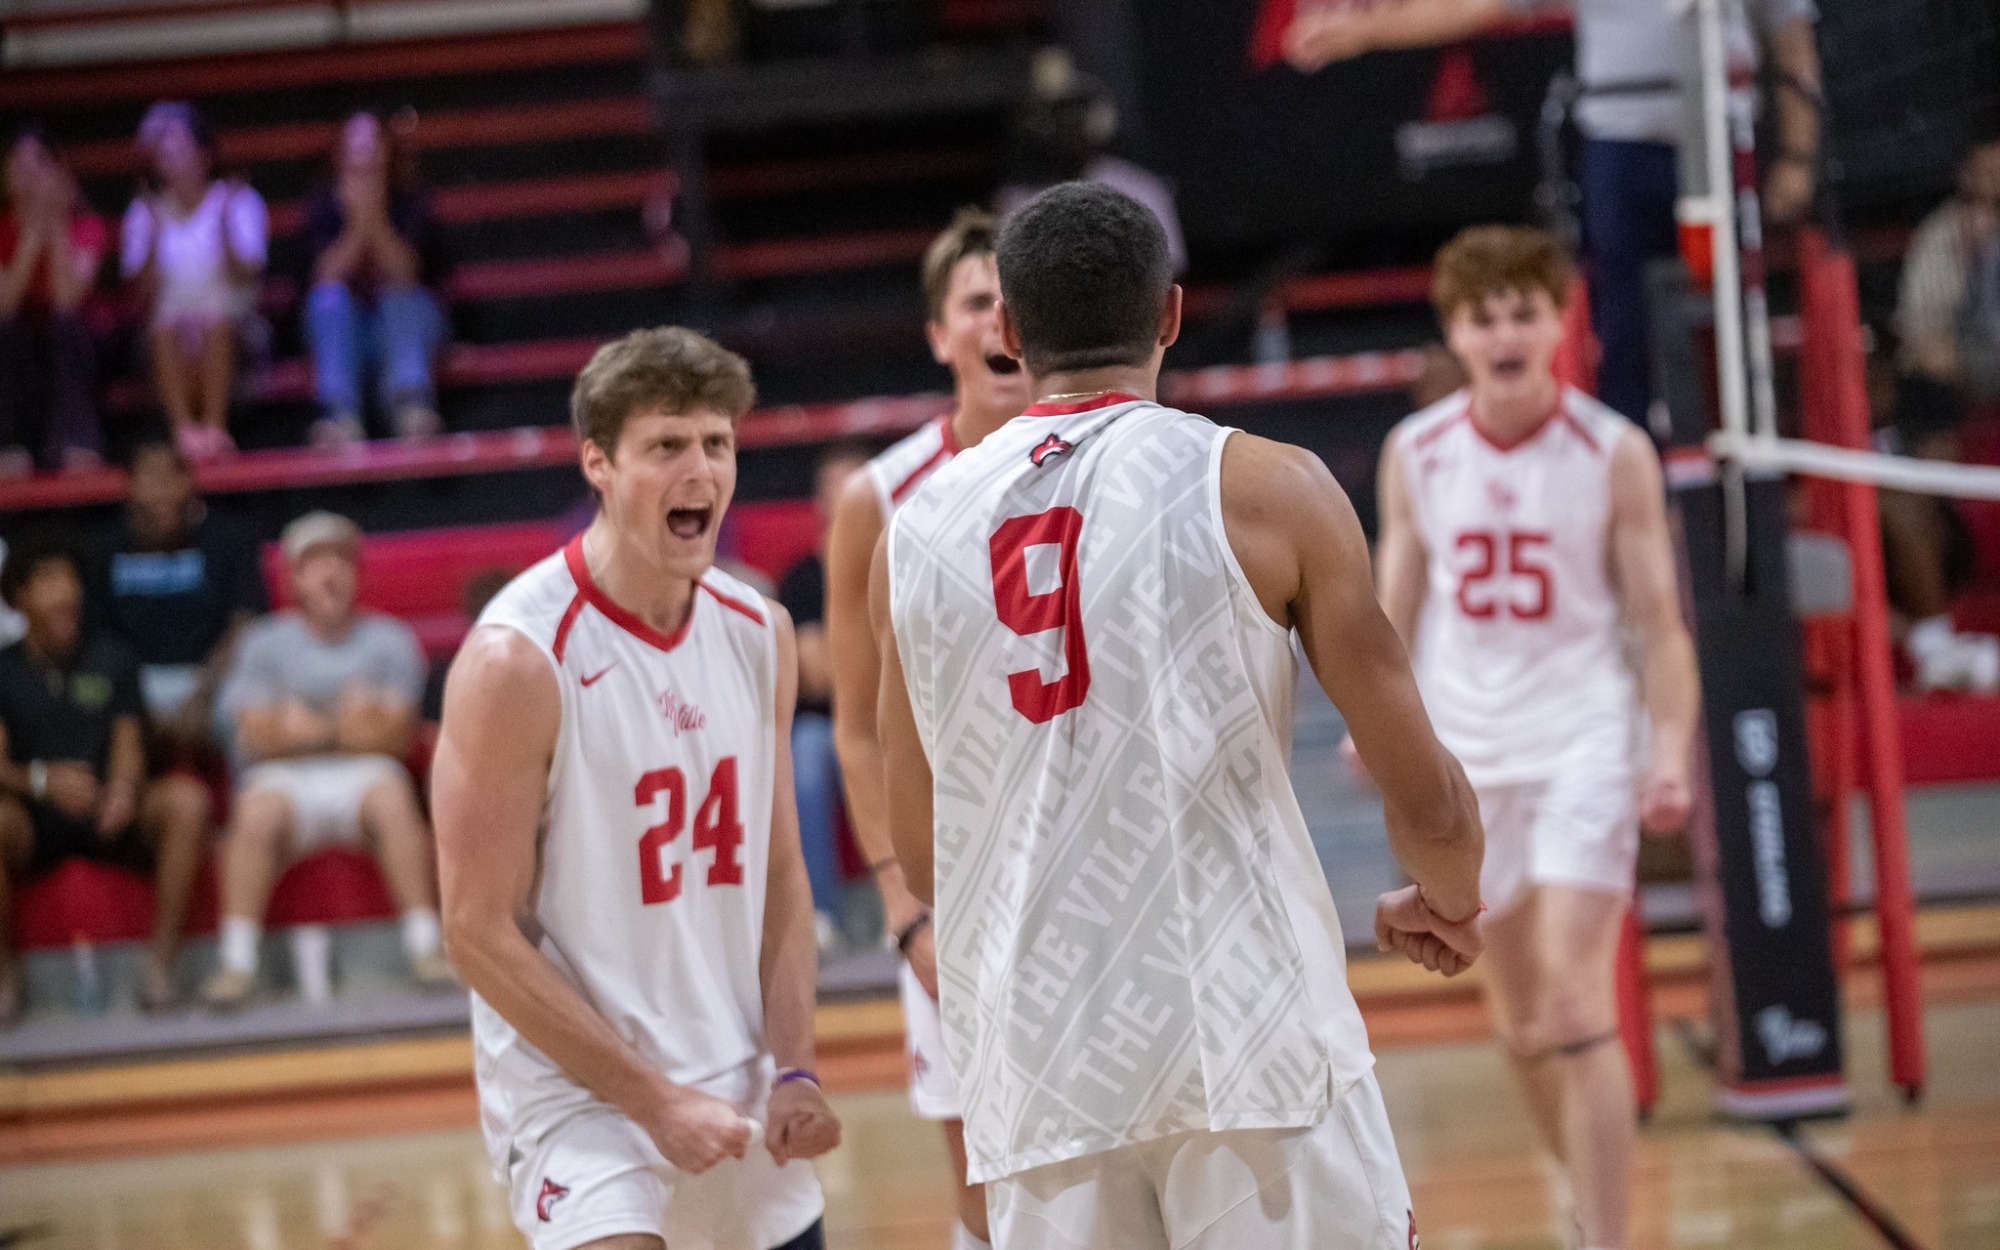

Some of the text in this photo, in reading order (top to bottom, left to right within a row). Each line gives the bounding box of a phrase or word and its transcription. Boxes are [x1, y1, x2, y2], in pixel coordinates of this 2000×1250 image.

[988, 506, 1091, 725] 9
[1456, 530, 1556, 619] 25
[635, 755, 745, 904] 24
[1067, 979, 1175, 1095] THE
